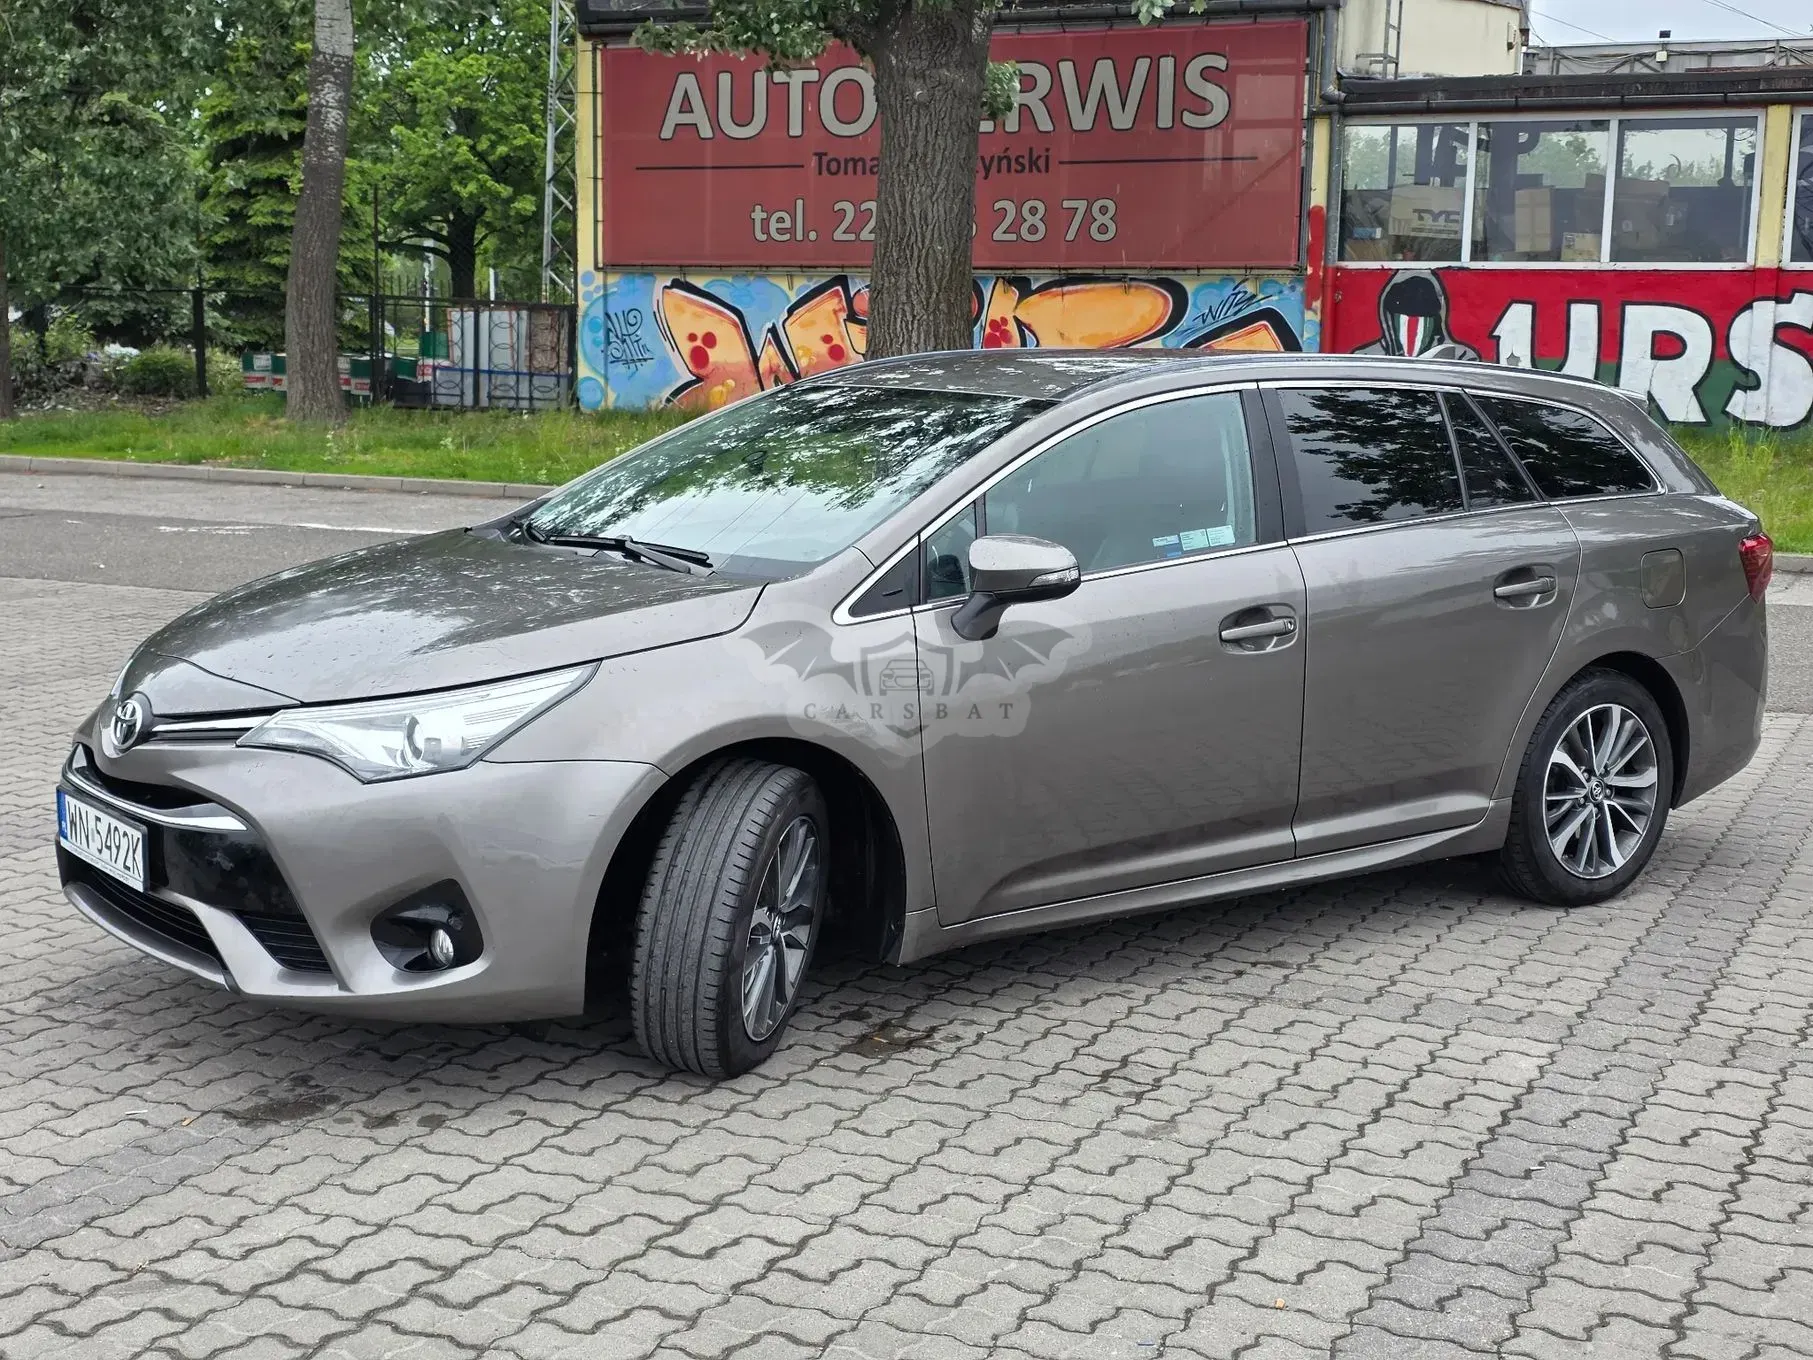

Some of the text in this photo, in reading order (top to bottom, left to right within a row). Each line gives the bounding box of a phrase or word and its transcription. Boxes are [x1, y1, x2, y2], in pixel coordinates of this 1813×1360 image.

[659, 53, 1231, 140] AUTO RWIS
[812, 146, 1051, 180] Toma yński
[750, 196, 818, 242] tel.
[992, 198, 1047, 242] 28
[1061, 197, 1118, 242] 78
[1412, 208, 1460, 223] TYC
[68, 801, 89, 849] WN
[95, 815, 141, 878] 5492K
